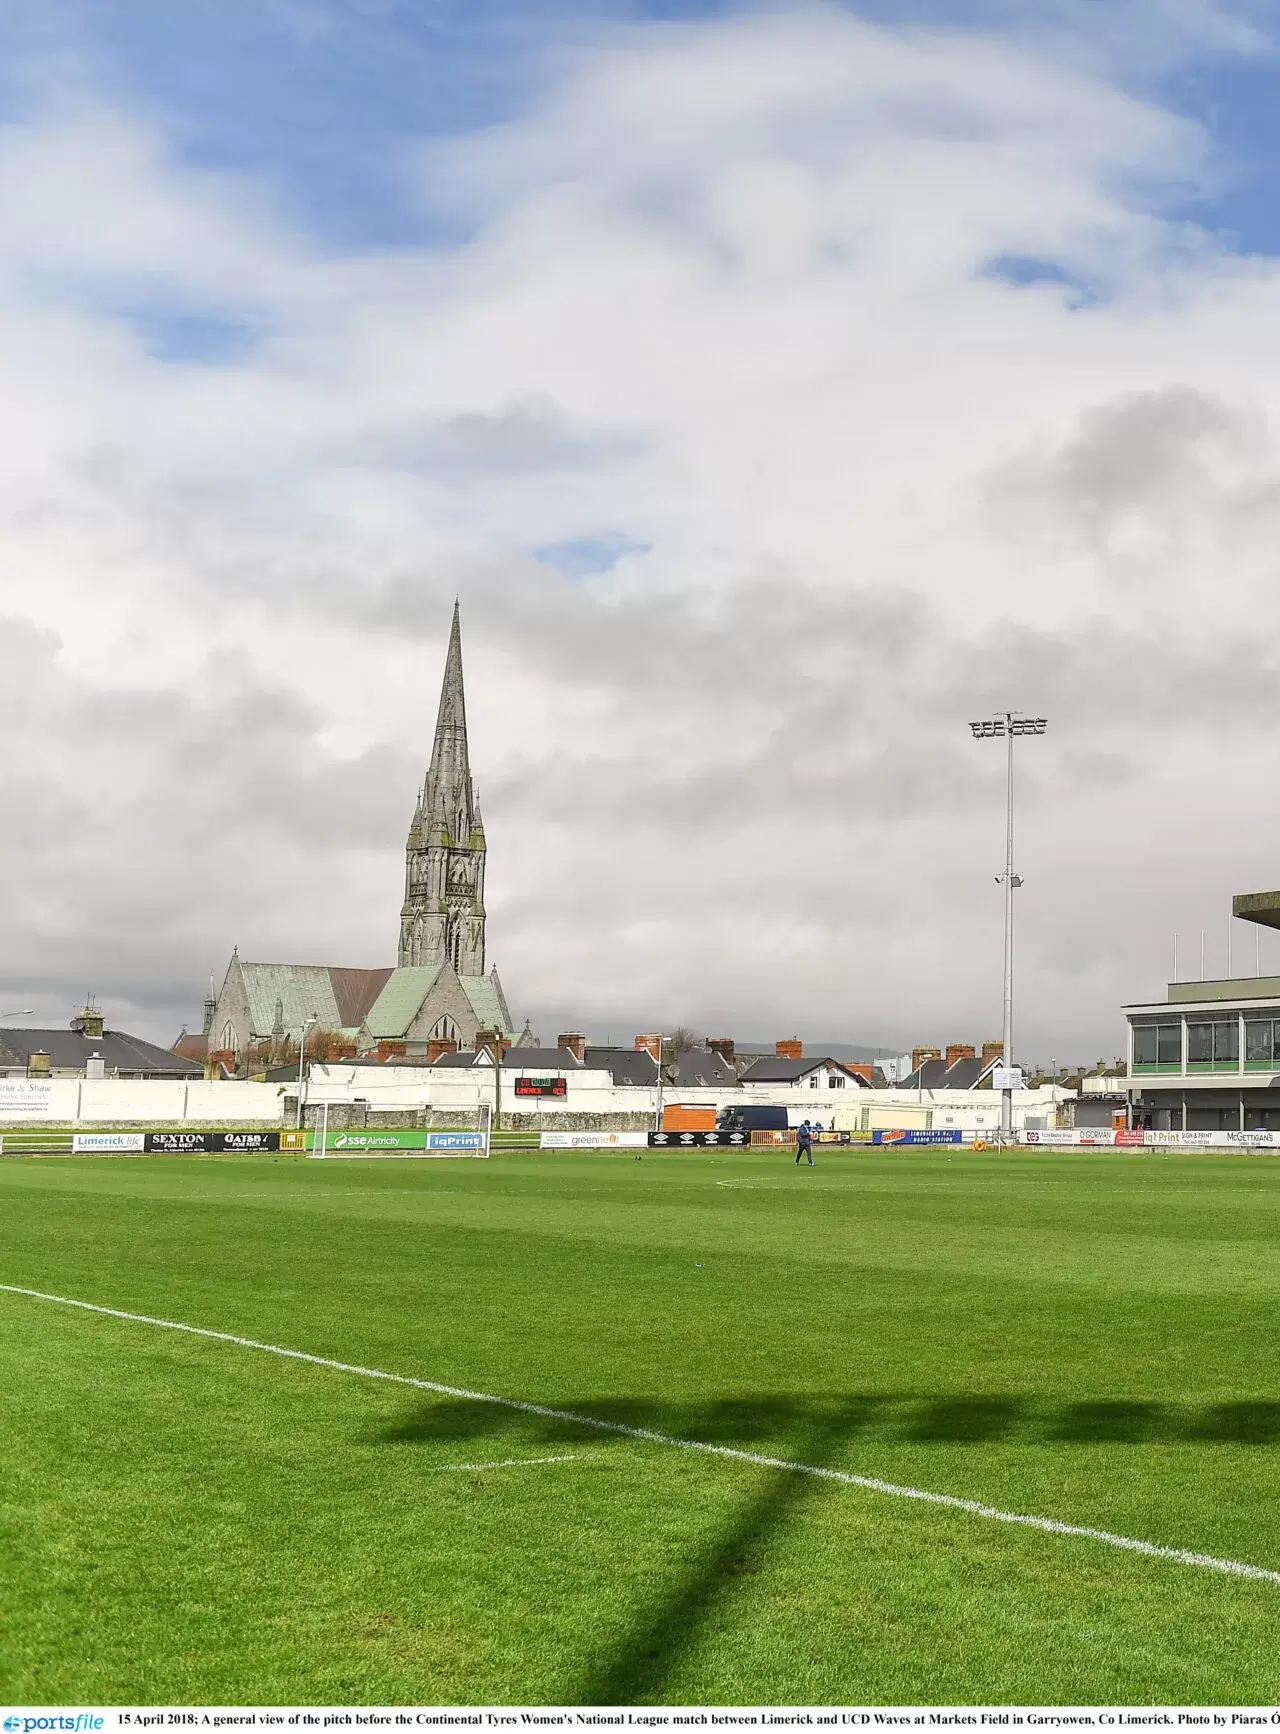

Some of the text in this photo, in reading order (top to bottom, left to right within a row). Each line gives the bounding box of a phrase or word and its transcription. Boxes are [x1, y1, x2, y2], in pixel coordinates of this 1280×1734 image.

[28, 1084, 51, 1092] Shaw
[78, 1136, 140, 1146] Limerick life
[152, 1134, 204, 1143] SEXTON
[348, 1136, 400, 1146] sse Airtricity
[435, 1135, 479, 1146] iqPrint
[1159, 1132, 1180, 1143] Print
